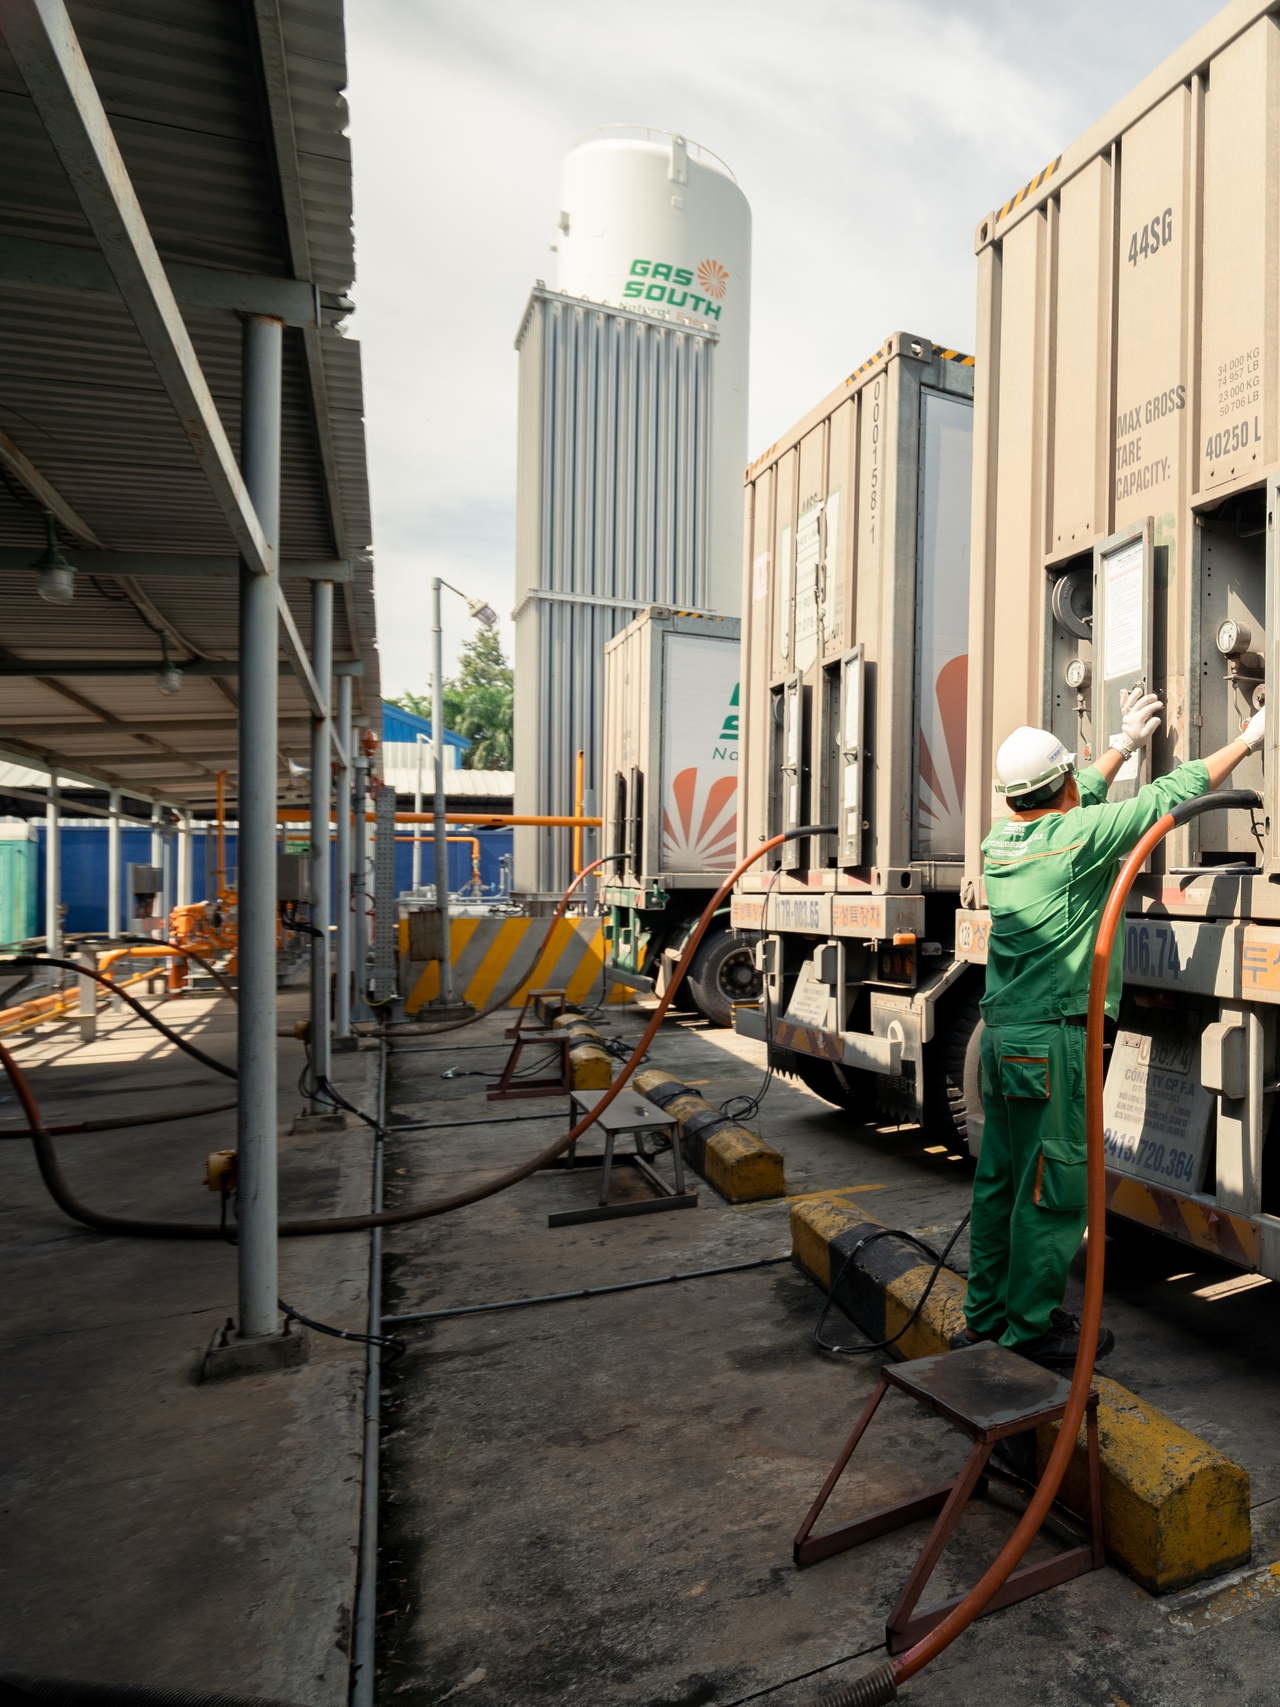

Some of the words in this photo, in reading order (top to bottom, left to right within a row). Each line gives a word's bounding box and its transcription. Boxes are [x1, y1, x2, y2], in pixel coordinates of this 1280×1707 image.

[1128, 208, 1173, 267] 44SG
[629, 259, 694, 286] GAS
[622, 281, 722, 321] SOUTH
[1217, 363, 1227, 377] 34
[1229, 355, 1244, 371] 000
[1246, 347, 1260, 362] KG
[1217, 376, 1227, 389] 74
[1229, 367, 1244, 384] 957
[1247, 359, 1259, 374] LB
[1218, 390, 1228, 403] 23
[1230, 382, 1245, 398] 000
[1246, 375, 1260, 390] KG
[1220, 404, 1229, 417] 50
[1231, 396, 1246, 412] 706
[1247, 390, 1259, 404] LB
[1117, 404, 1142, 439] MAX
[1145, 384, 1186, 425] GROSS
[1116, 436, 1142, 470] TARE
[1205, 420, 1249, 461] 40250
[1254, 415, 1262, 442] L
[1115, 456, 1171, 501] CAPACITY:
[1123, 926, 1180, 980] 06.74
[1125, 1067, 1150, 1085] CÔNG
[1153, 1074, 1164, 1088] TY
[1165, 1078, 1179, 1092] CP
